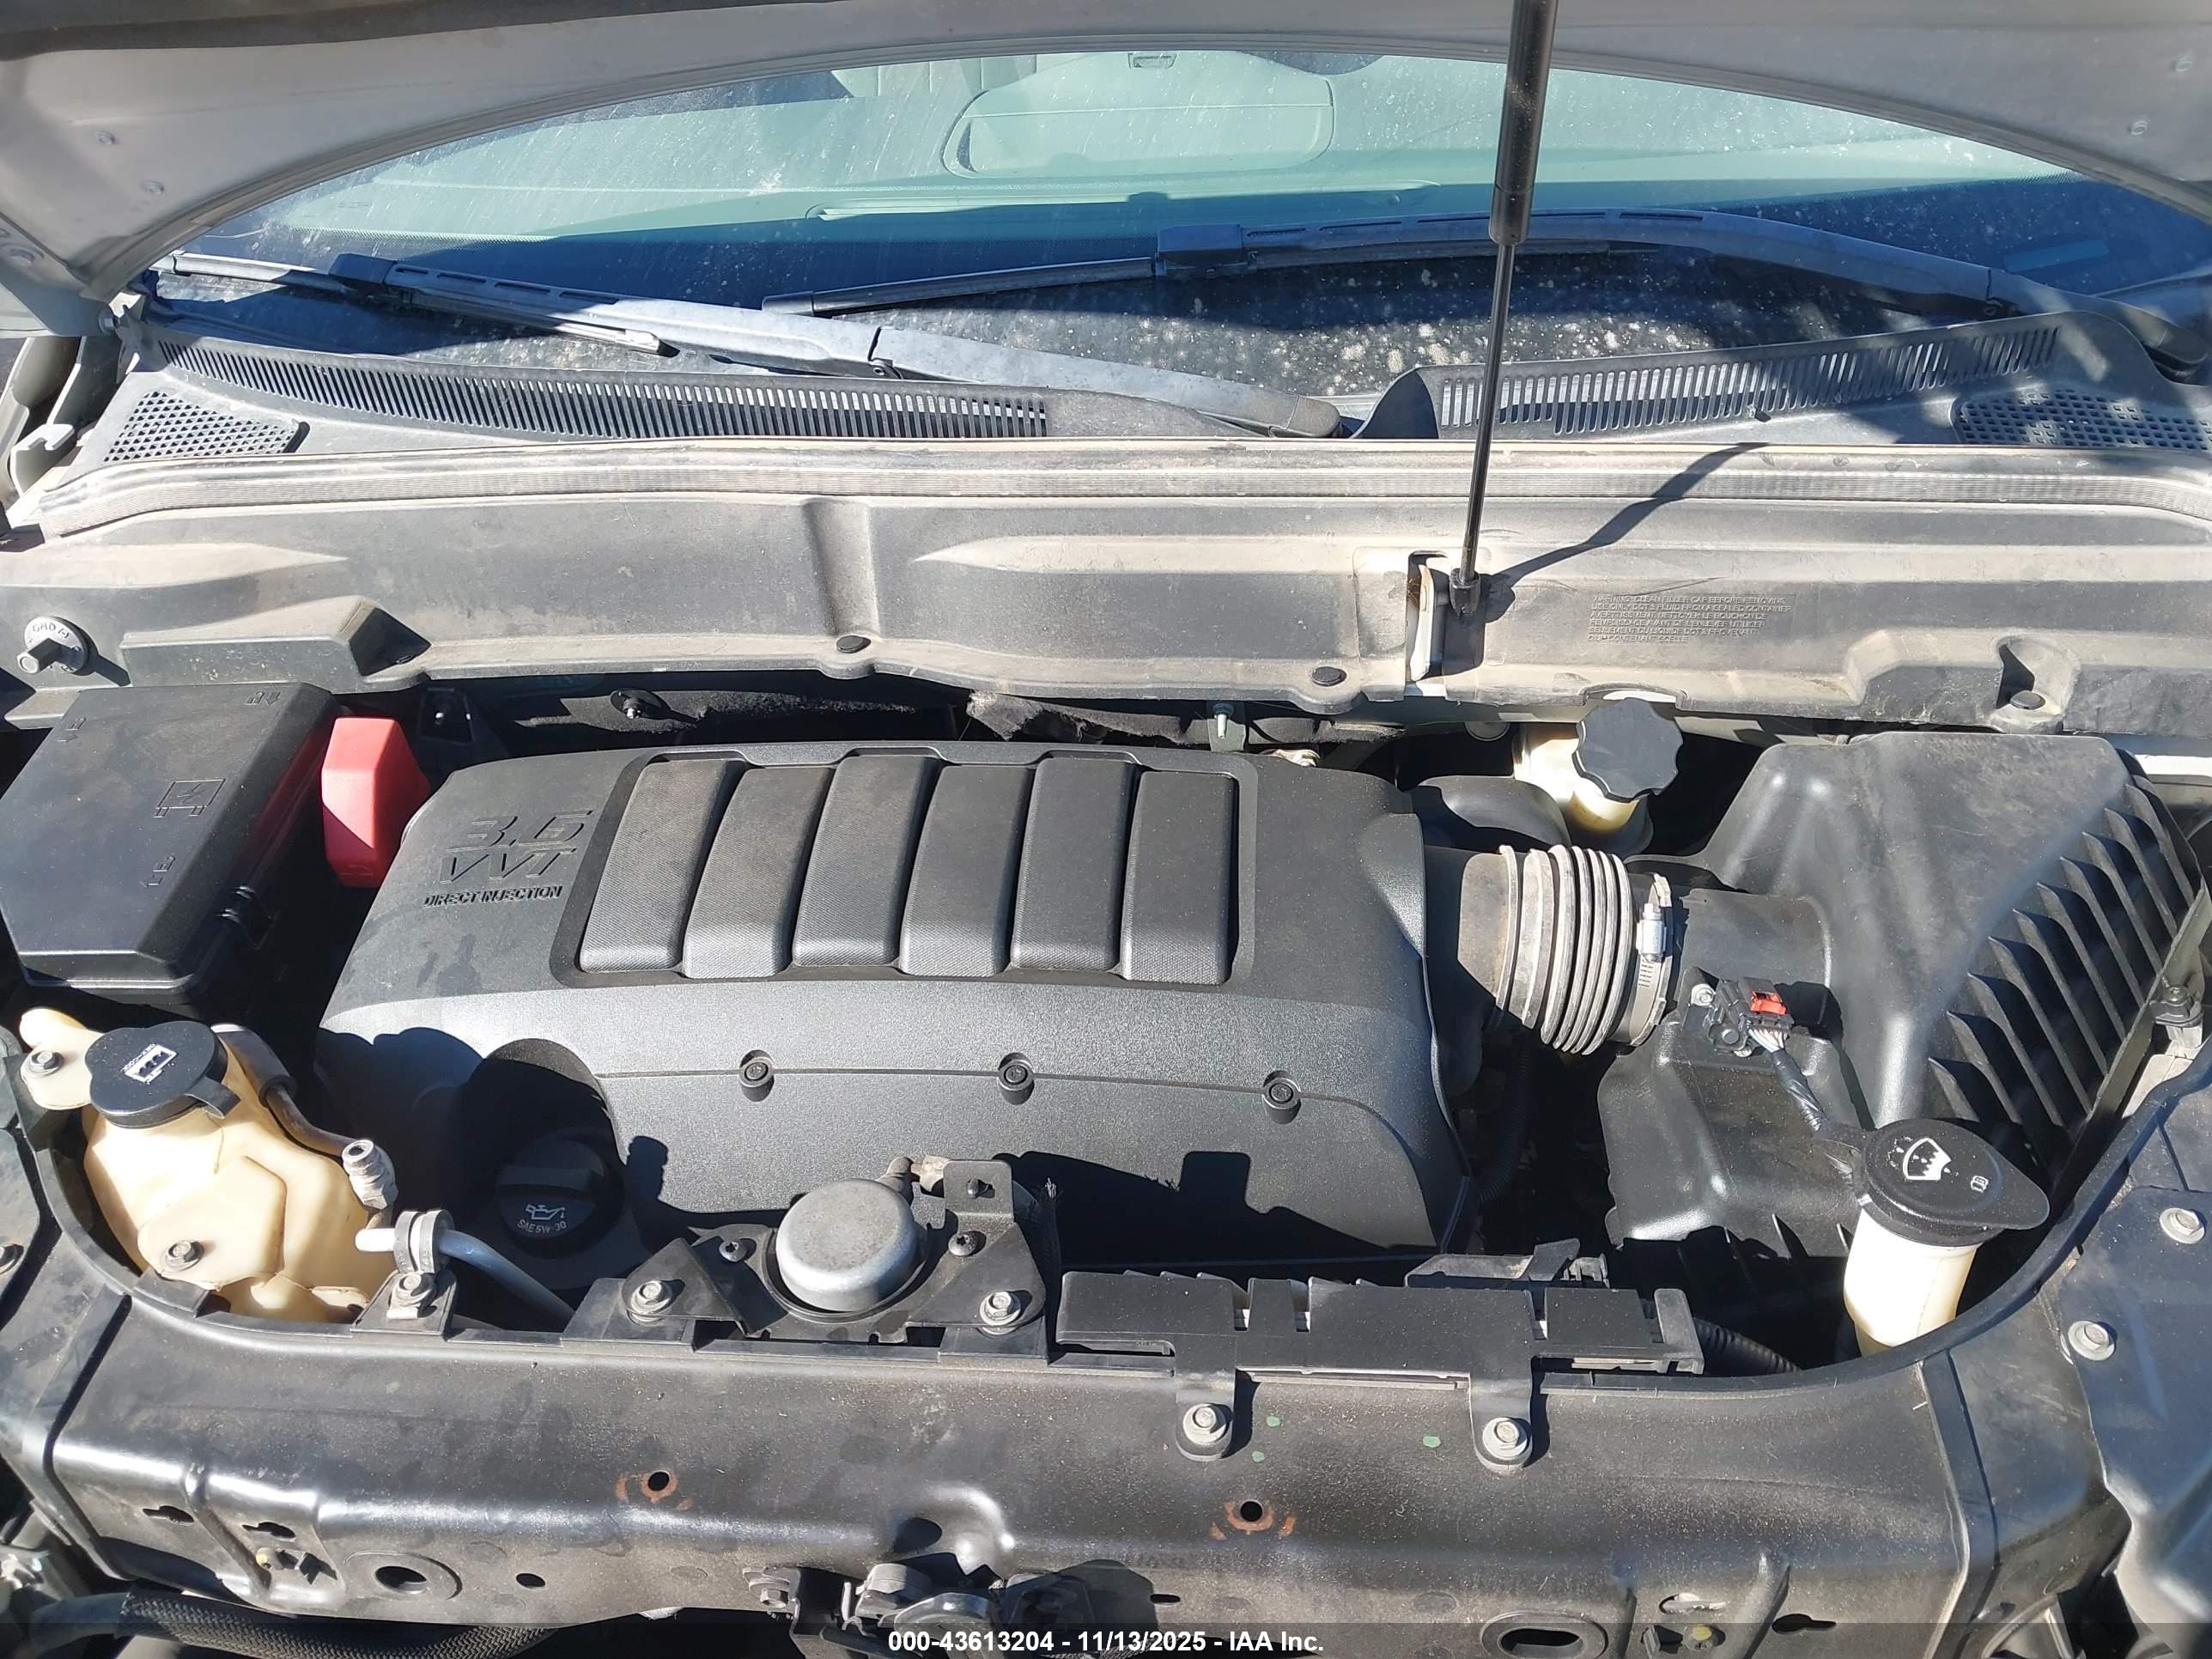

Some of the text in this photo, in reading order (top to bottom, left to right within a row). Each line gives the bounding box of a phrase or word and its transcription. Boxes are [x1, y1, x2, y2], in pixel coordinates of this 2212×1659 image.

[447, 810, 592, 853] 3.6
[439, 848, 577, 884] VVT
[422, 885, 563, 908] DIRECT INJECTION
[517, 1218, 536, 1233] SAE
